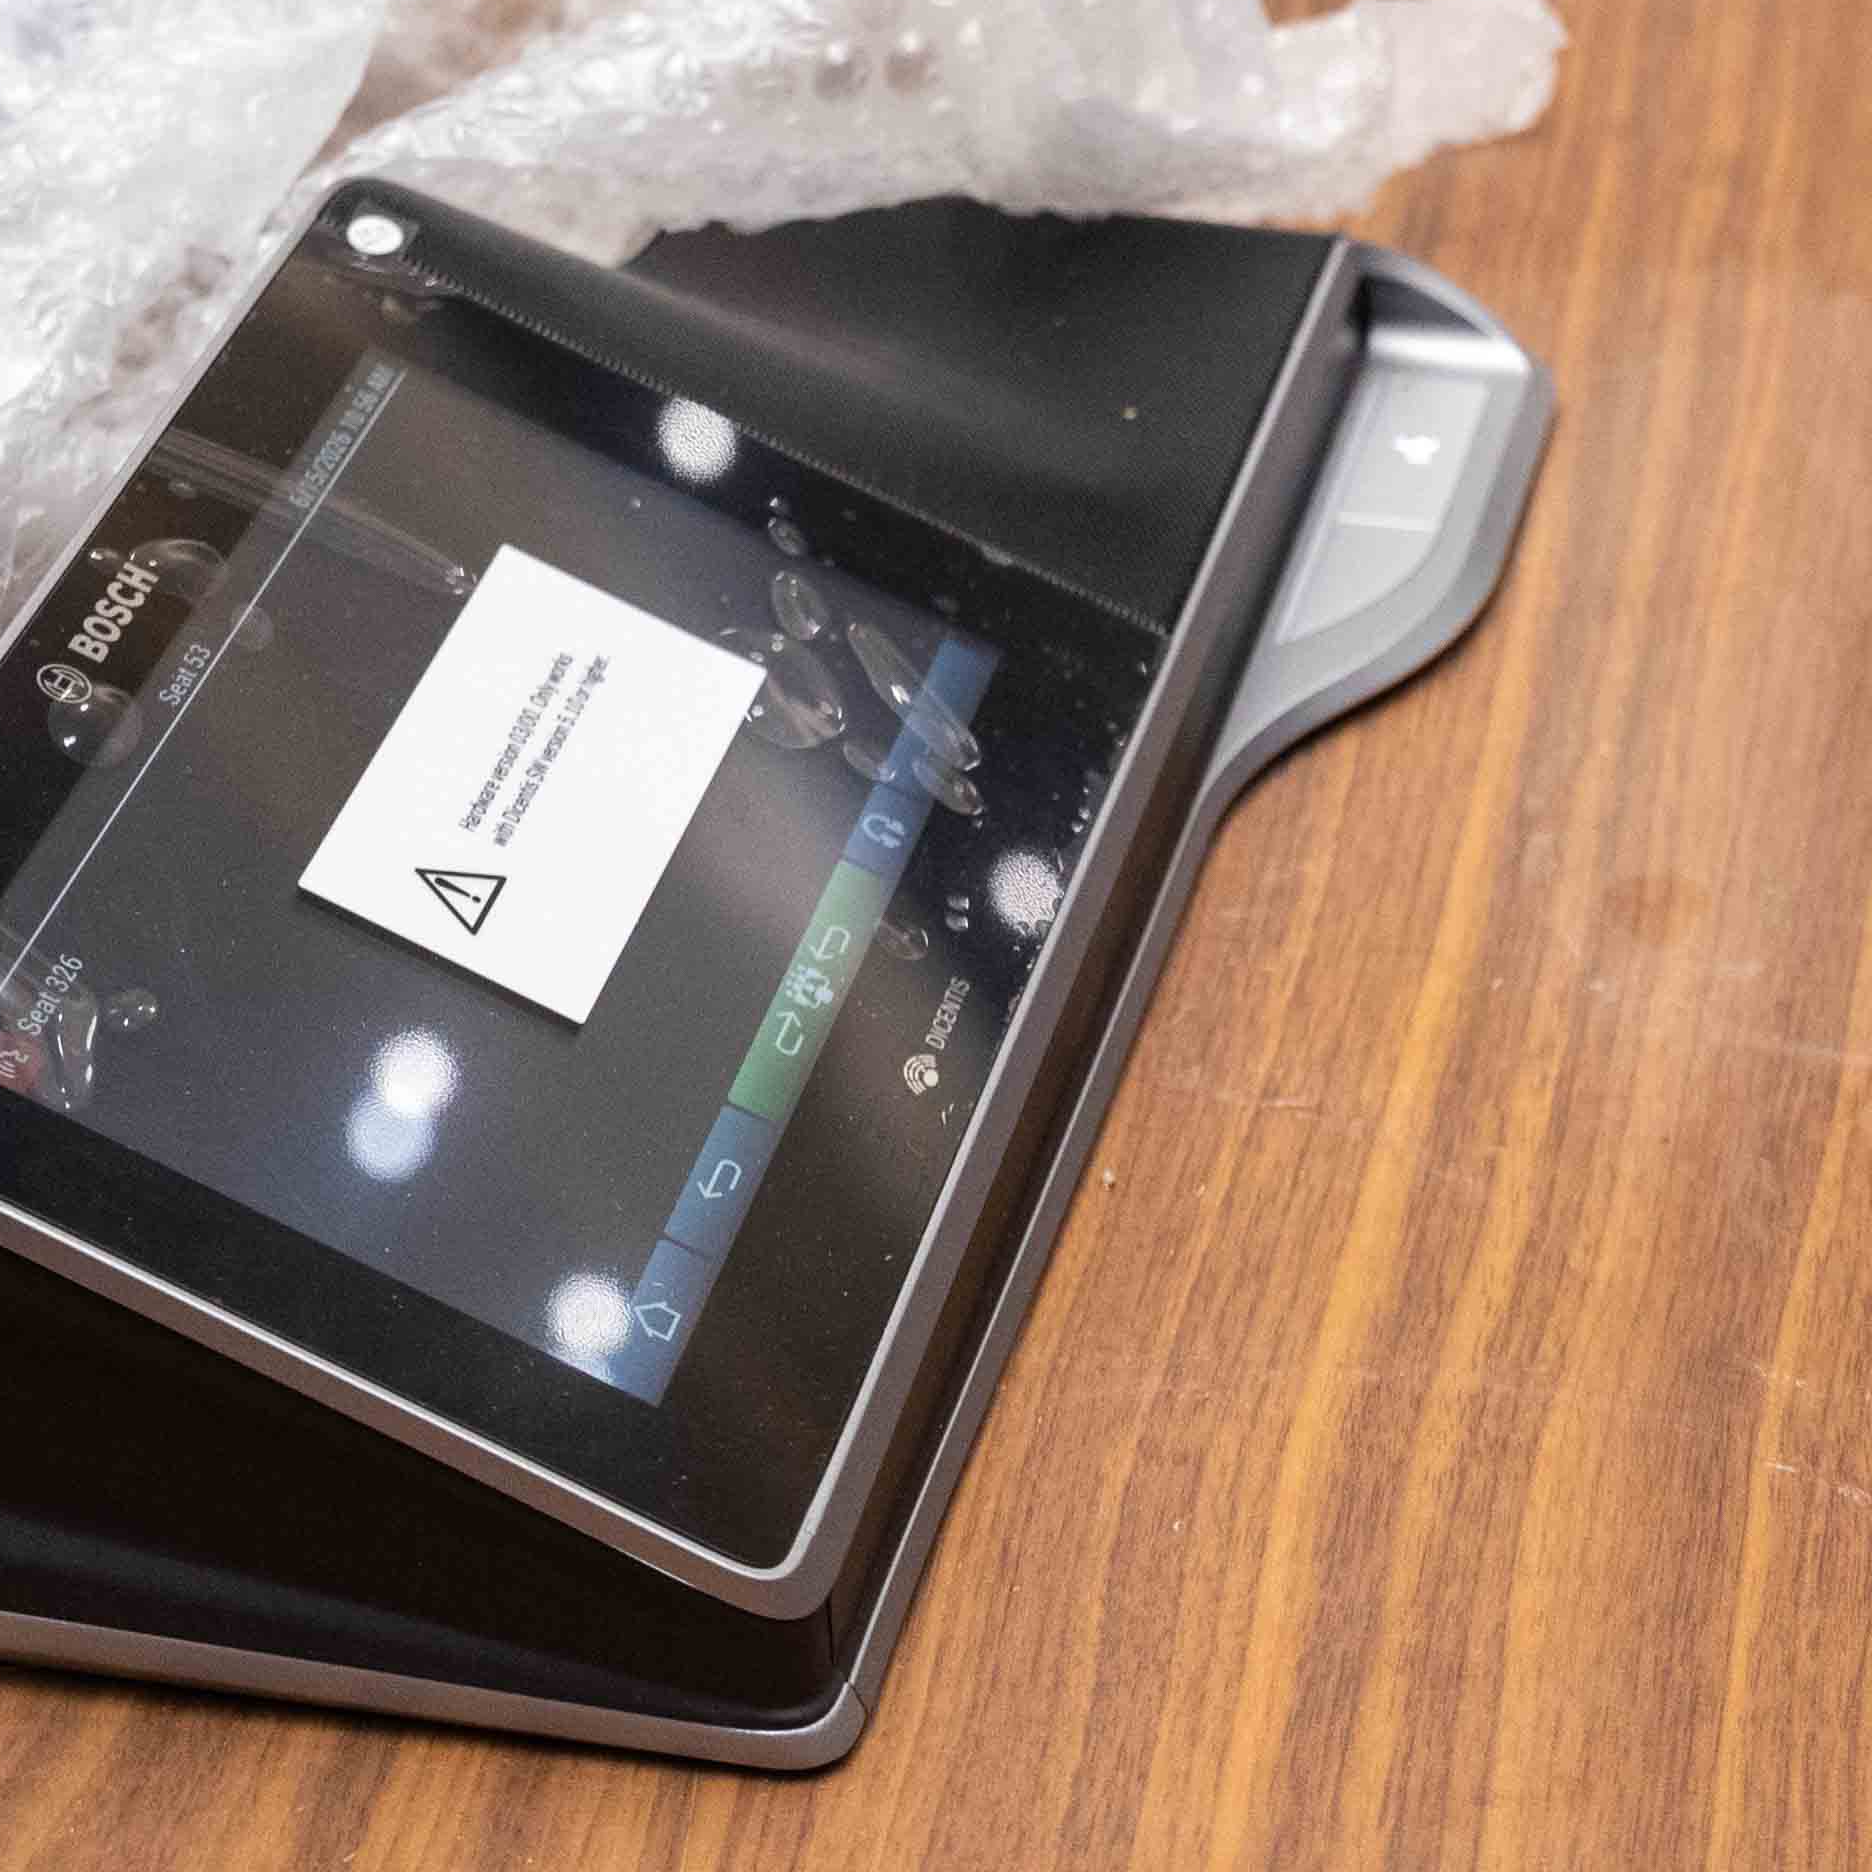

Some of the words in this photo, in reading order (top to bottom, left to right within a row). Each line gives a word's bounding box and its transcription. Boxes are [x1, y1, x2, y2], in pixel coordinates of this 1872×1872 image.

[68, 561, 159, 663] BOSCH
[159, 668, 196, 706] Seat
[184, 643, 211, 669] 53
[459, 780, 500, 831] Hardware
[491, 742, 521, 780] version
[530, 682, 558, 708] Only
[547, 652, 574, 683] works
[526, 760, 549, 781] SW
[542, 725, 569, 762] version
[503, 779, 539, 823] Dicentis
[492, 821, 515, 846] with
[17, 990, 60, 1035] Seat
[45, 953, 83, 992] 326
[926, 977, 969, 1049] DICENTIS
